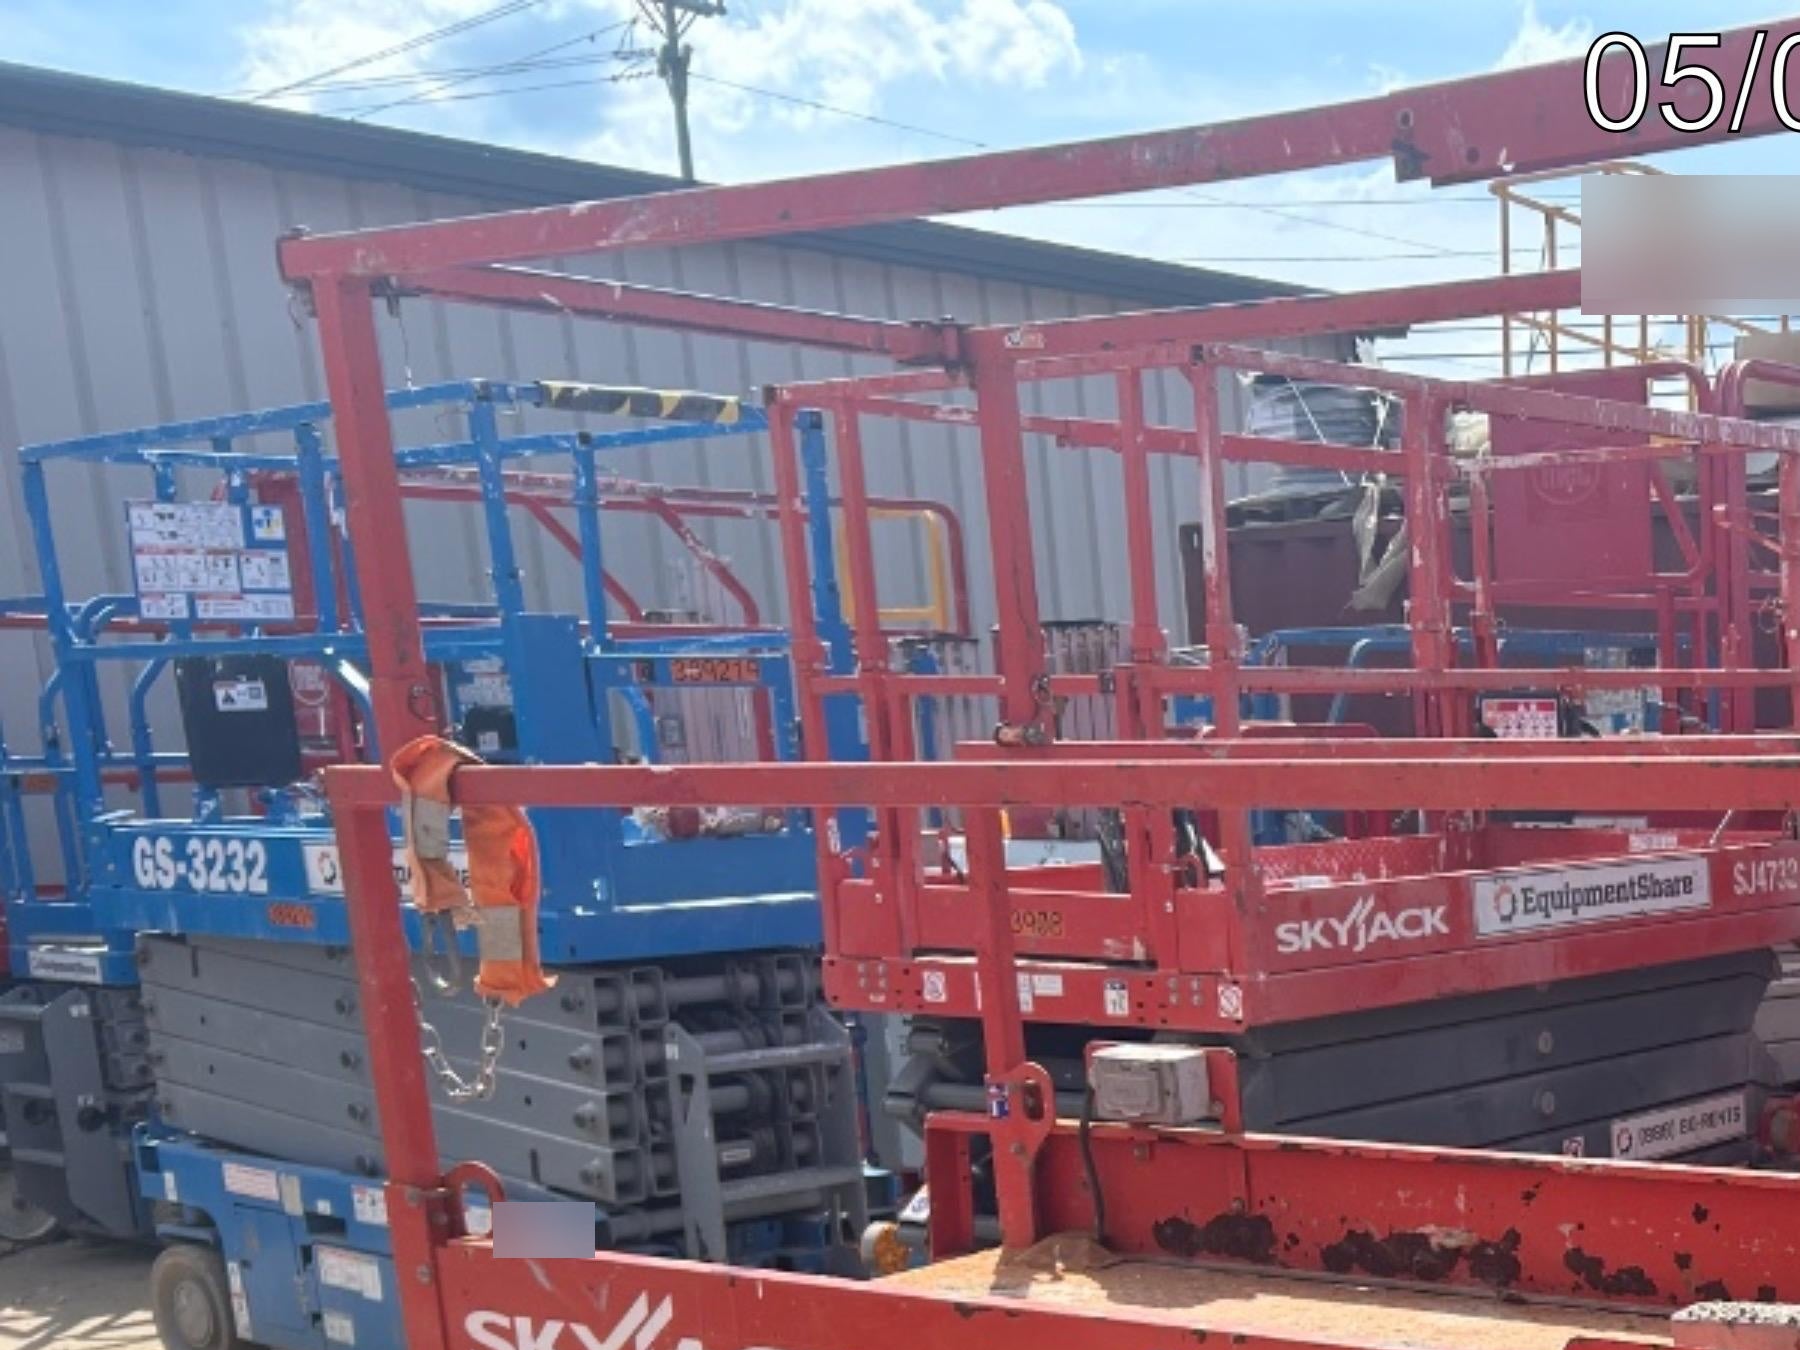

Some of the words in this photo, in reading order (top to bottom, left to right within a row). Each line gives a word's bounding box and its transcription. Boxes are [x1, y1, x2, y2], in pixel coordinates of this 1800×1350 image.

[133, 836, 269, 895] GS-3232
[1733, 858, 1799, 896] SJ4732
[1520, 874, 1694, 919] EquipmentShare
[1275, 895, 1450, 955] SKYJACK
